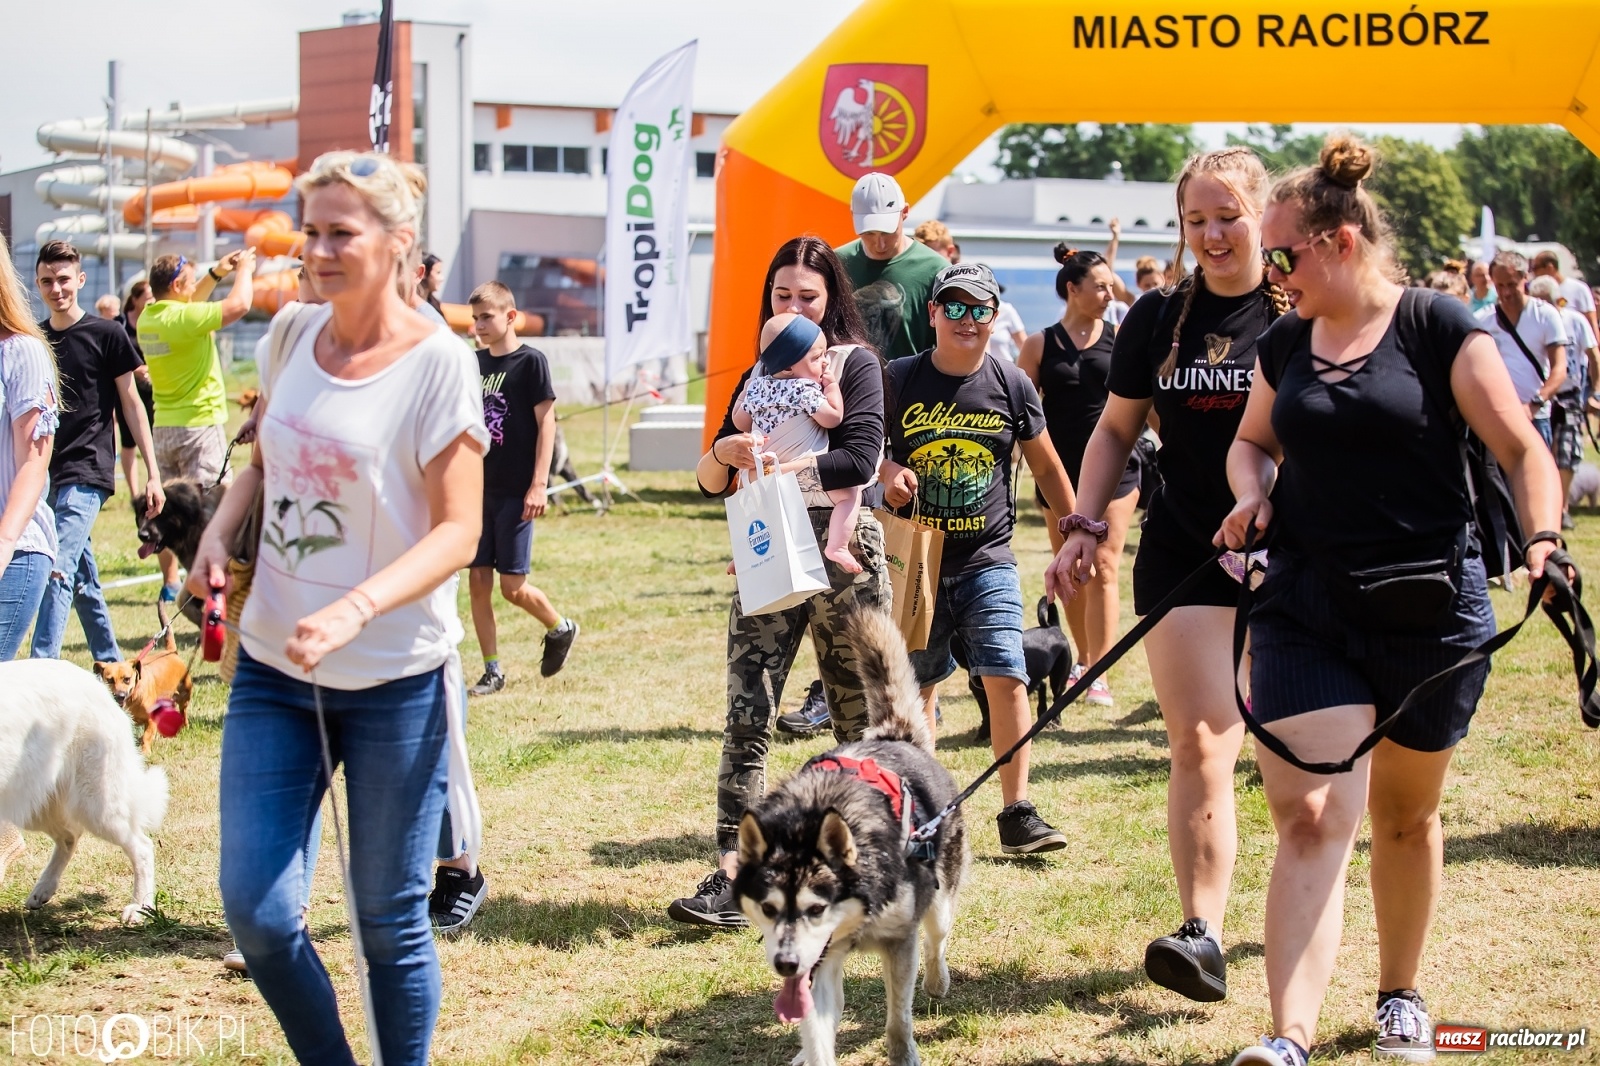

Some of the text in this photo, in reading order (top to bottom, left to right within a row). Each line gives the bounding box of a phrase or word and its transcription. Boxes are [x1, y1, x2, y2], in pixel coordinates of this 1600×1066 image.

[1072, 4, 1490, 49] MIASTO RACIBÓRZ
[625, 122, 661, 333] TropiDog
[1158, 367, 1255, 392] GUINNES
[901, 401, 1006, 438] California
[908, 429, 998, 451] SUMMER PARADISE
[938, 508, 960, 517] TREE
[947, 515, 986, 531] COAST
[748, 531, 771, 548] Farmina
[911, 562, 924, 617] www.tropidog.pl
